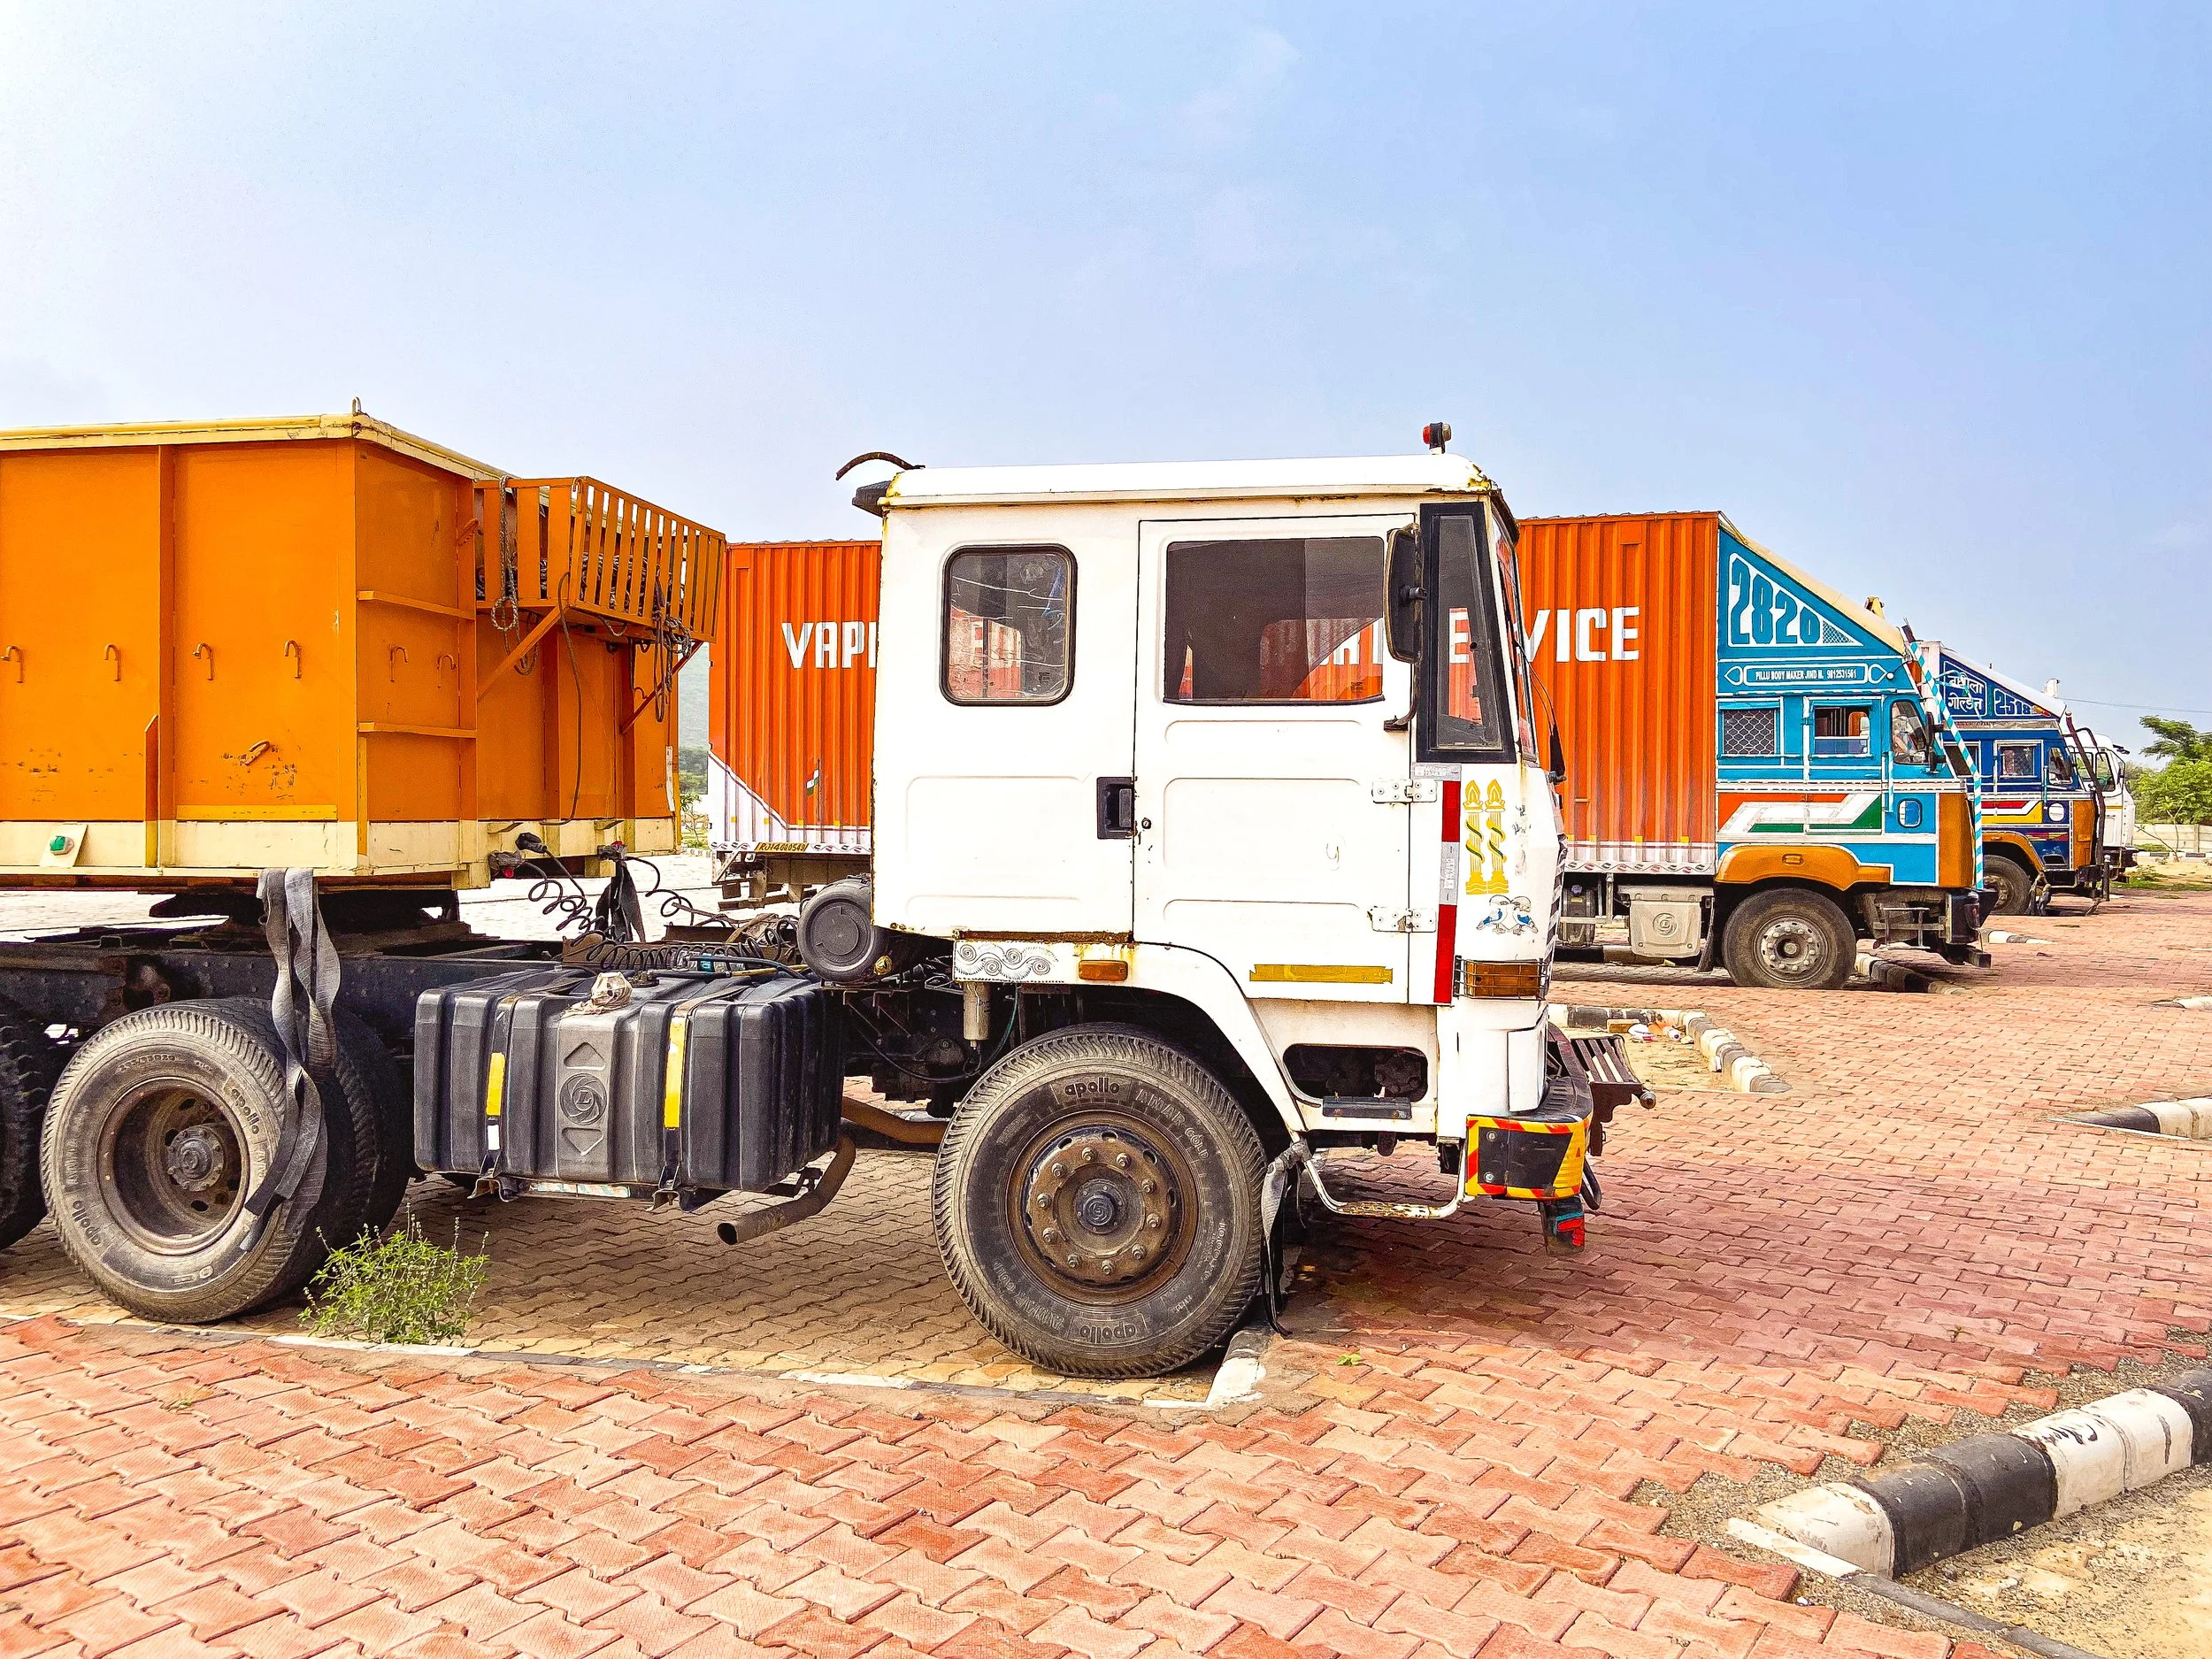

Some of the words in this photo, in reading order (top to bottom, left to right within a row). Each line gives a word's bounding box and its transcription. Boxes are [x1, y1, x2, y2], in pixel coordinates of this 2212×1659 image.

[1731, 557, 1820, 644] 2820
[1770, 671, 1785, 680] BODY
[1786, 670, 1805, 680] MAKER
[1994, 689, 2032, 714] 2518
[231, 1088, 260, 1134] apollo
[1064, 1077, 1120, 1097] apollo
[1135, 1089, 1186, 1126] AMAR
[1185, 1127, 1210, 1160] GOLD
[1079, 1321, 1136, 1344] apollo
